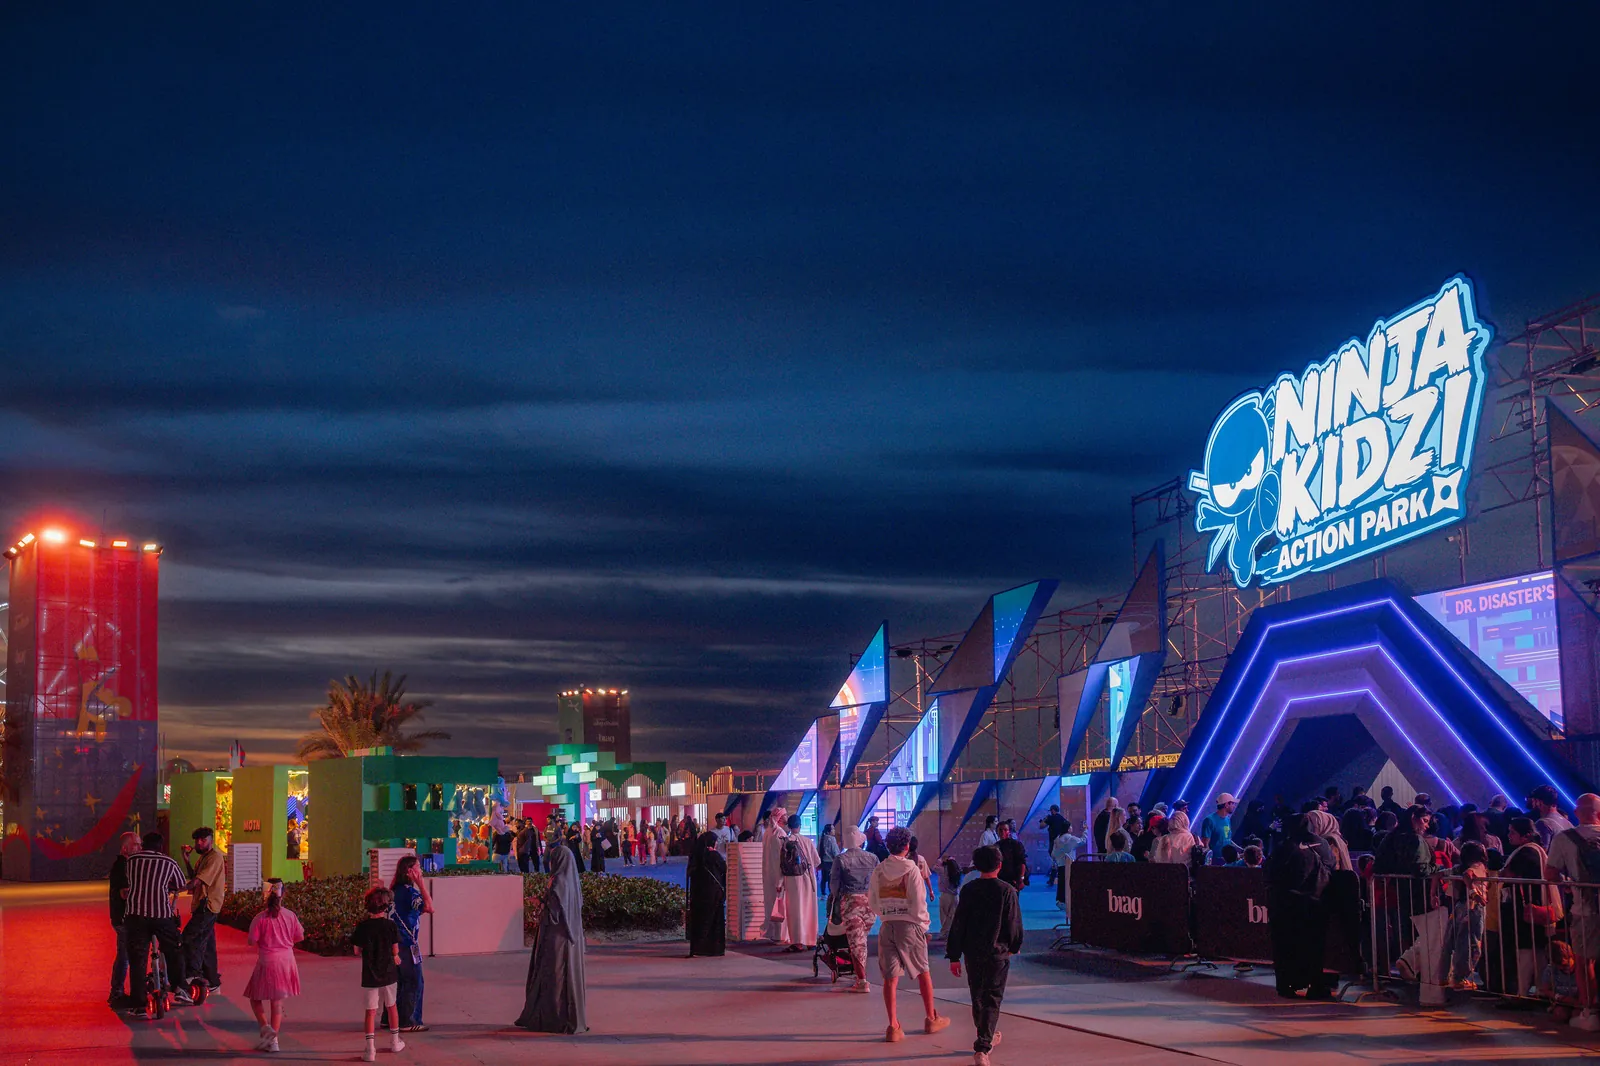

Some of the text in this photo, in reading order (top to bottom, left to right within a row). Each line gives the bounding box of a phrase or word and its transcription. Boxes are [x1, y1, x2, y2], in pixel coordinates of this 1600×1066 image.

[1272, 285, 1478, 466] NINJA
[1277, 487, 1430, 573] ACTION PARK
[1455, 599, 1476, 615] DR.
[1107, 888, 1142, 921] brag
